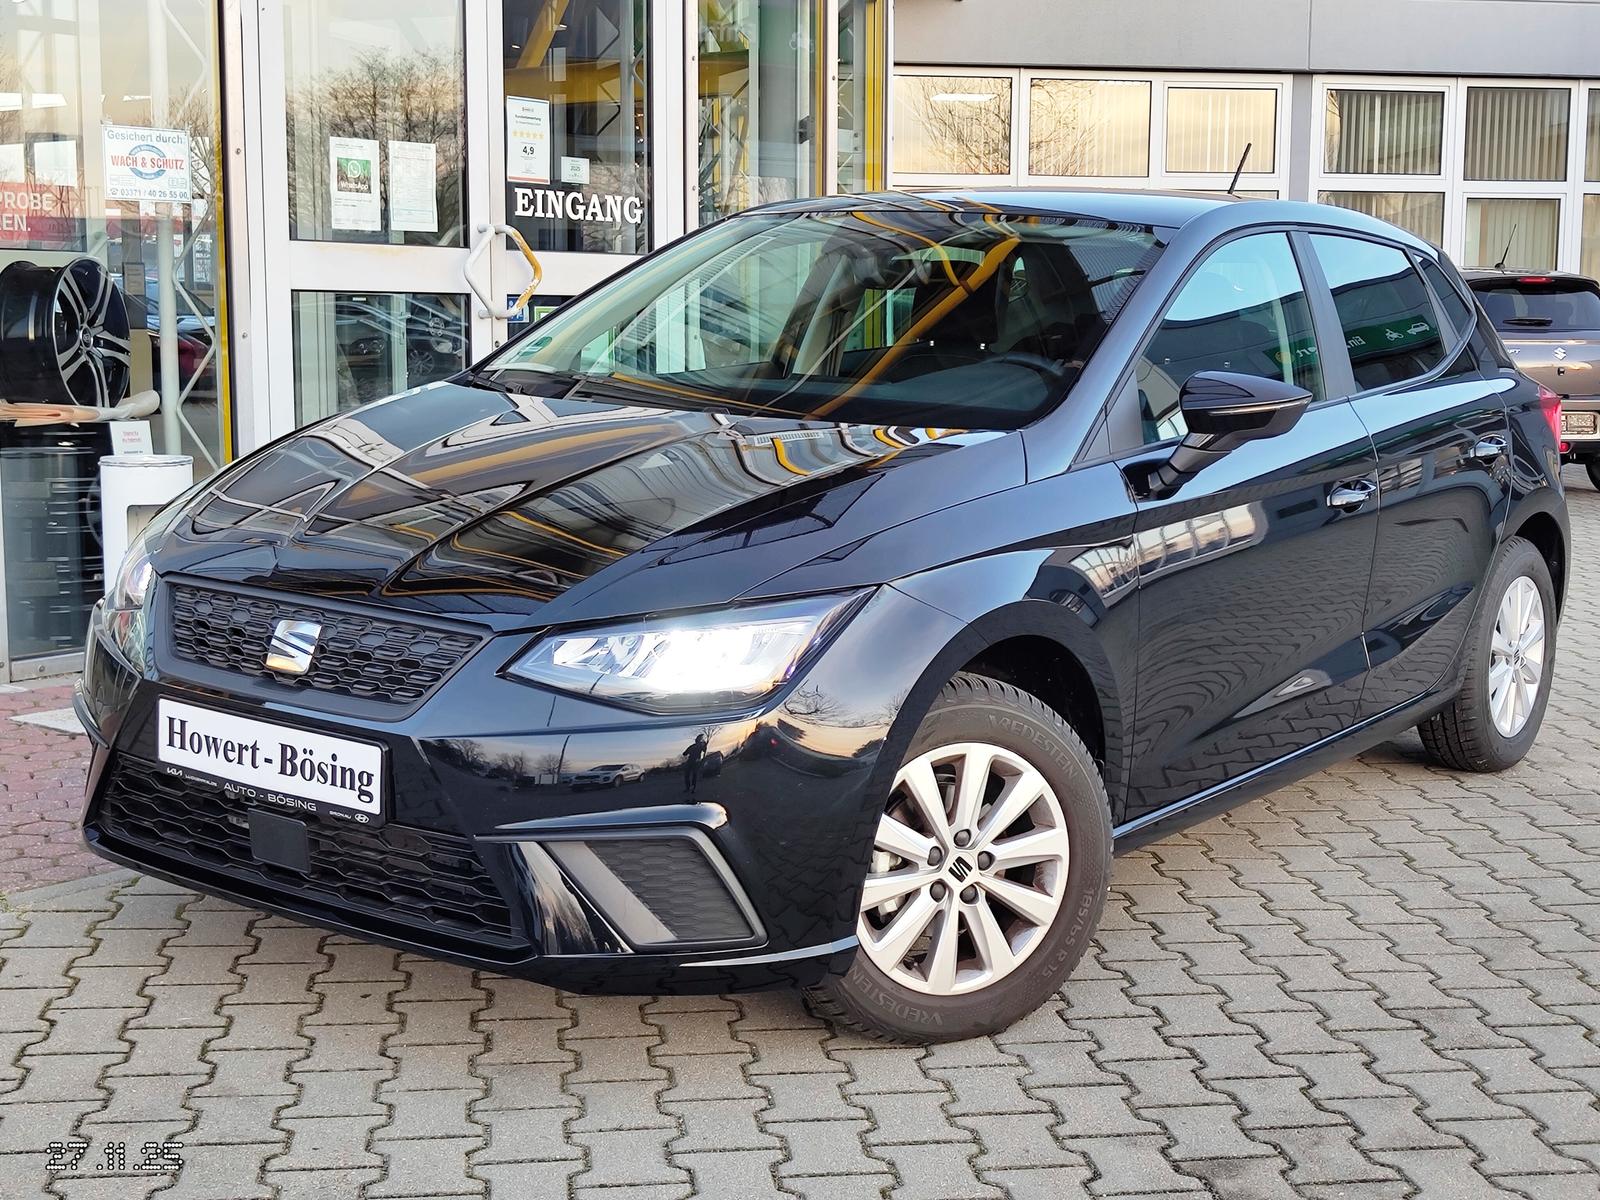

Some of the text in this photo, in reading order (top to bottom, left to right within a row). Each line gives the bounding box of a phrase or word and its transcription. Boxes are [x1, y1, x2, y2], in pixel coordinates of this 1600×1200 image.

[107, 130, 153, 142] Gesichert
[522, 146, 535, 156] 4,9
[111, 155, 185, 170] WACH & SCHUTZ
[340, 181, 369, 191] WhatsApp
[514, 188, 644, 224] EINGANG
[0, 213, 31, 232] EN.
[223, 782, 257, 798] AUTO
[267, 792, 318, 812] BÖSING
